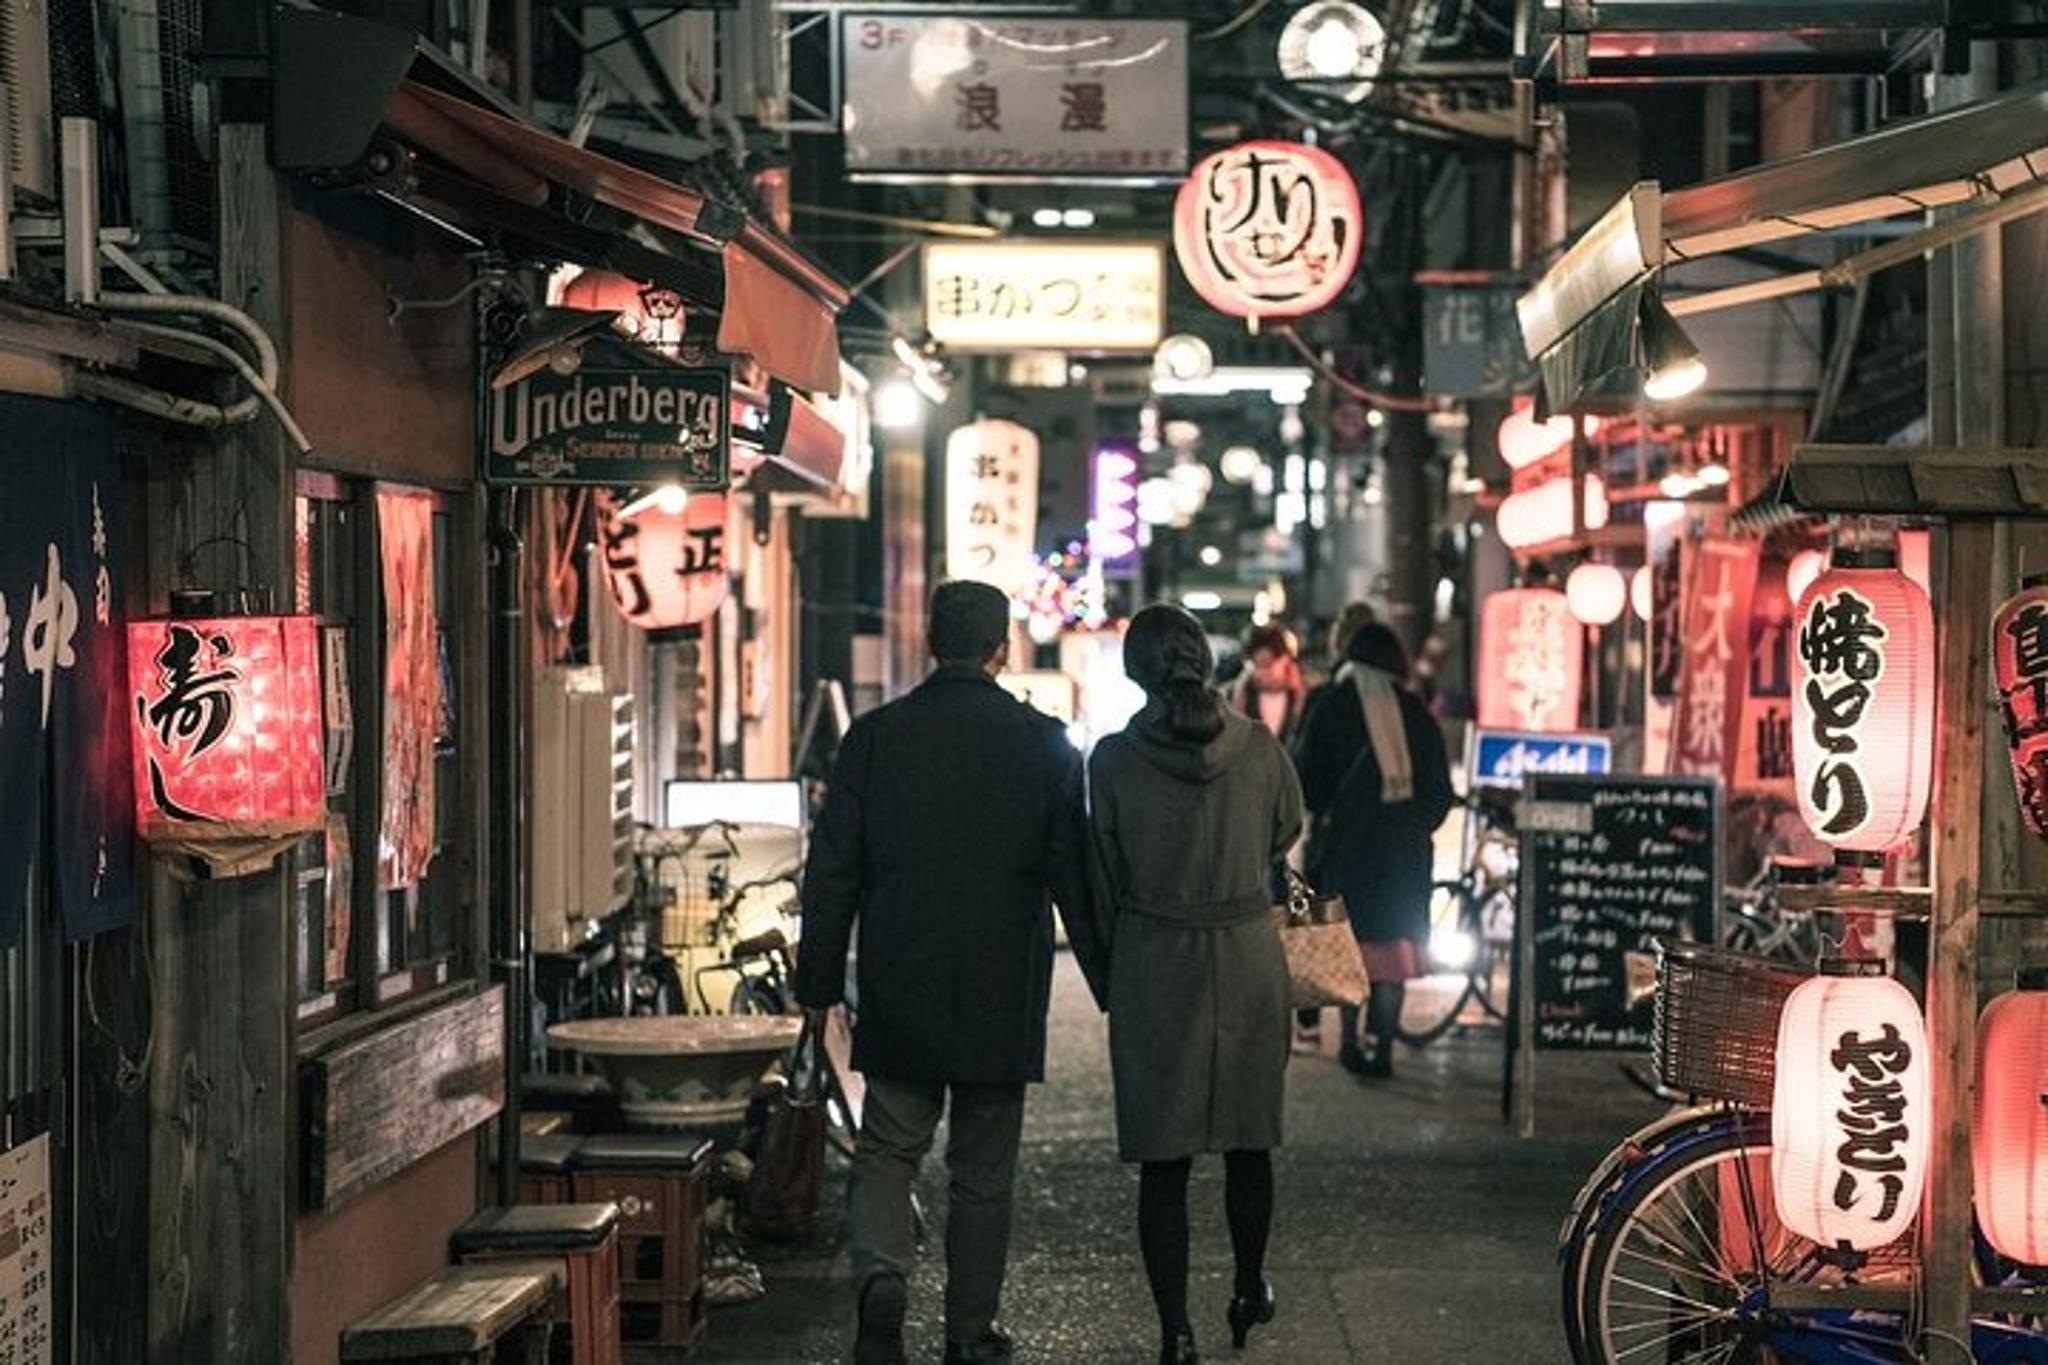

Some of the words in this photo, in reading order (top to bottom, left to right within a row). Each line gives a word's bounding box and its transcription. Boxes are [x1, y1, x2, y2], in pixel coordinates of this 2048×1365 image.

[492, 373, 720, 457] Underberg
[1800, 591, 1886, 835] 焼とり
[1830, 1022, 1913, 1223] やきとり
